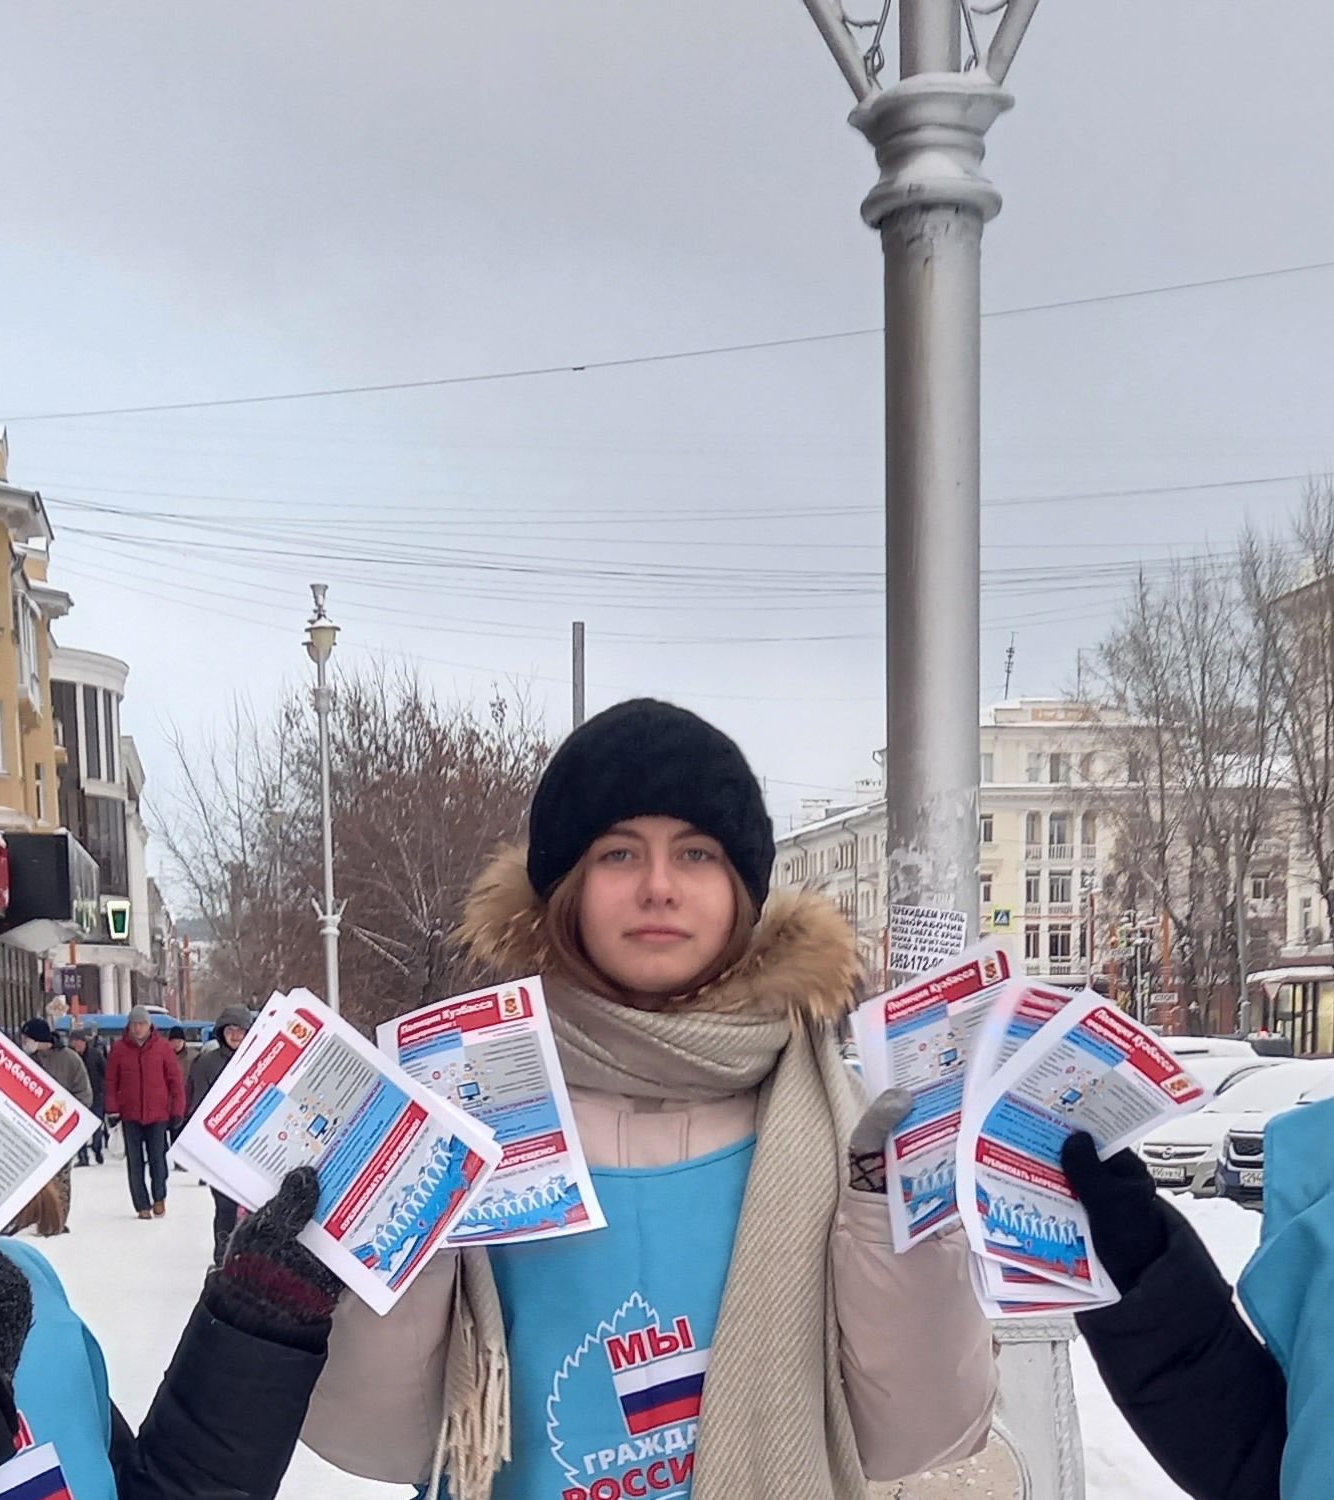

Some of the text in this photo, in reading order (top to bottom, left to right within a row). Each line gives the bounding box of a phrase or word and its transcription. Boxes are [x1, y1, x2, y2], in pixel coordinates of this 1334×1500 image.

[441, 997, 494, 1021] Кузбасса
[1094, 1006, 1176, 1073] Полиция Кузбасса
[206, 1084, 247, 1129] Полиция
[241, 1038, 286, 1087] Кузбасса
[603, 1315, 695, 1373] МЫ
[582, 1423, 699, 1476] ГРАЖДА
